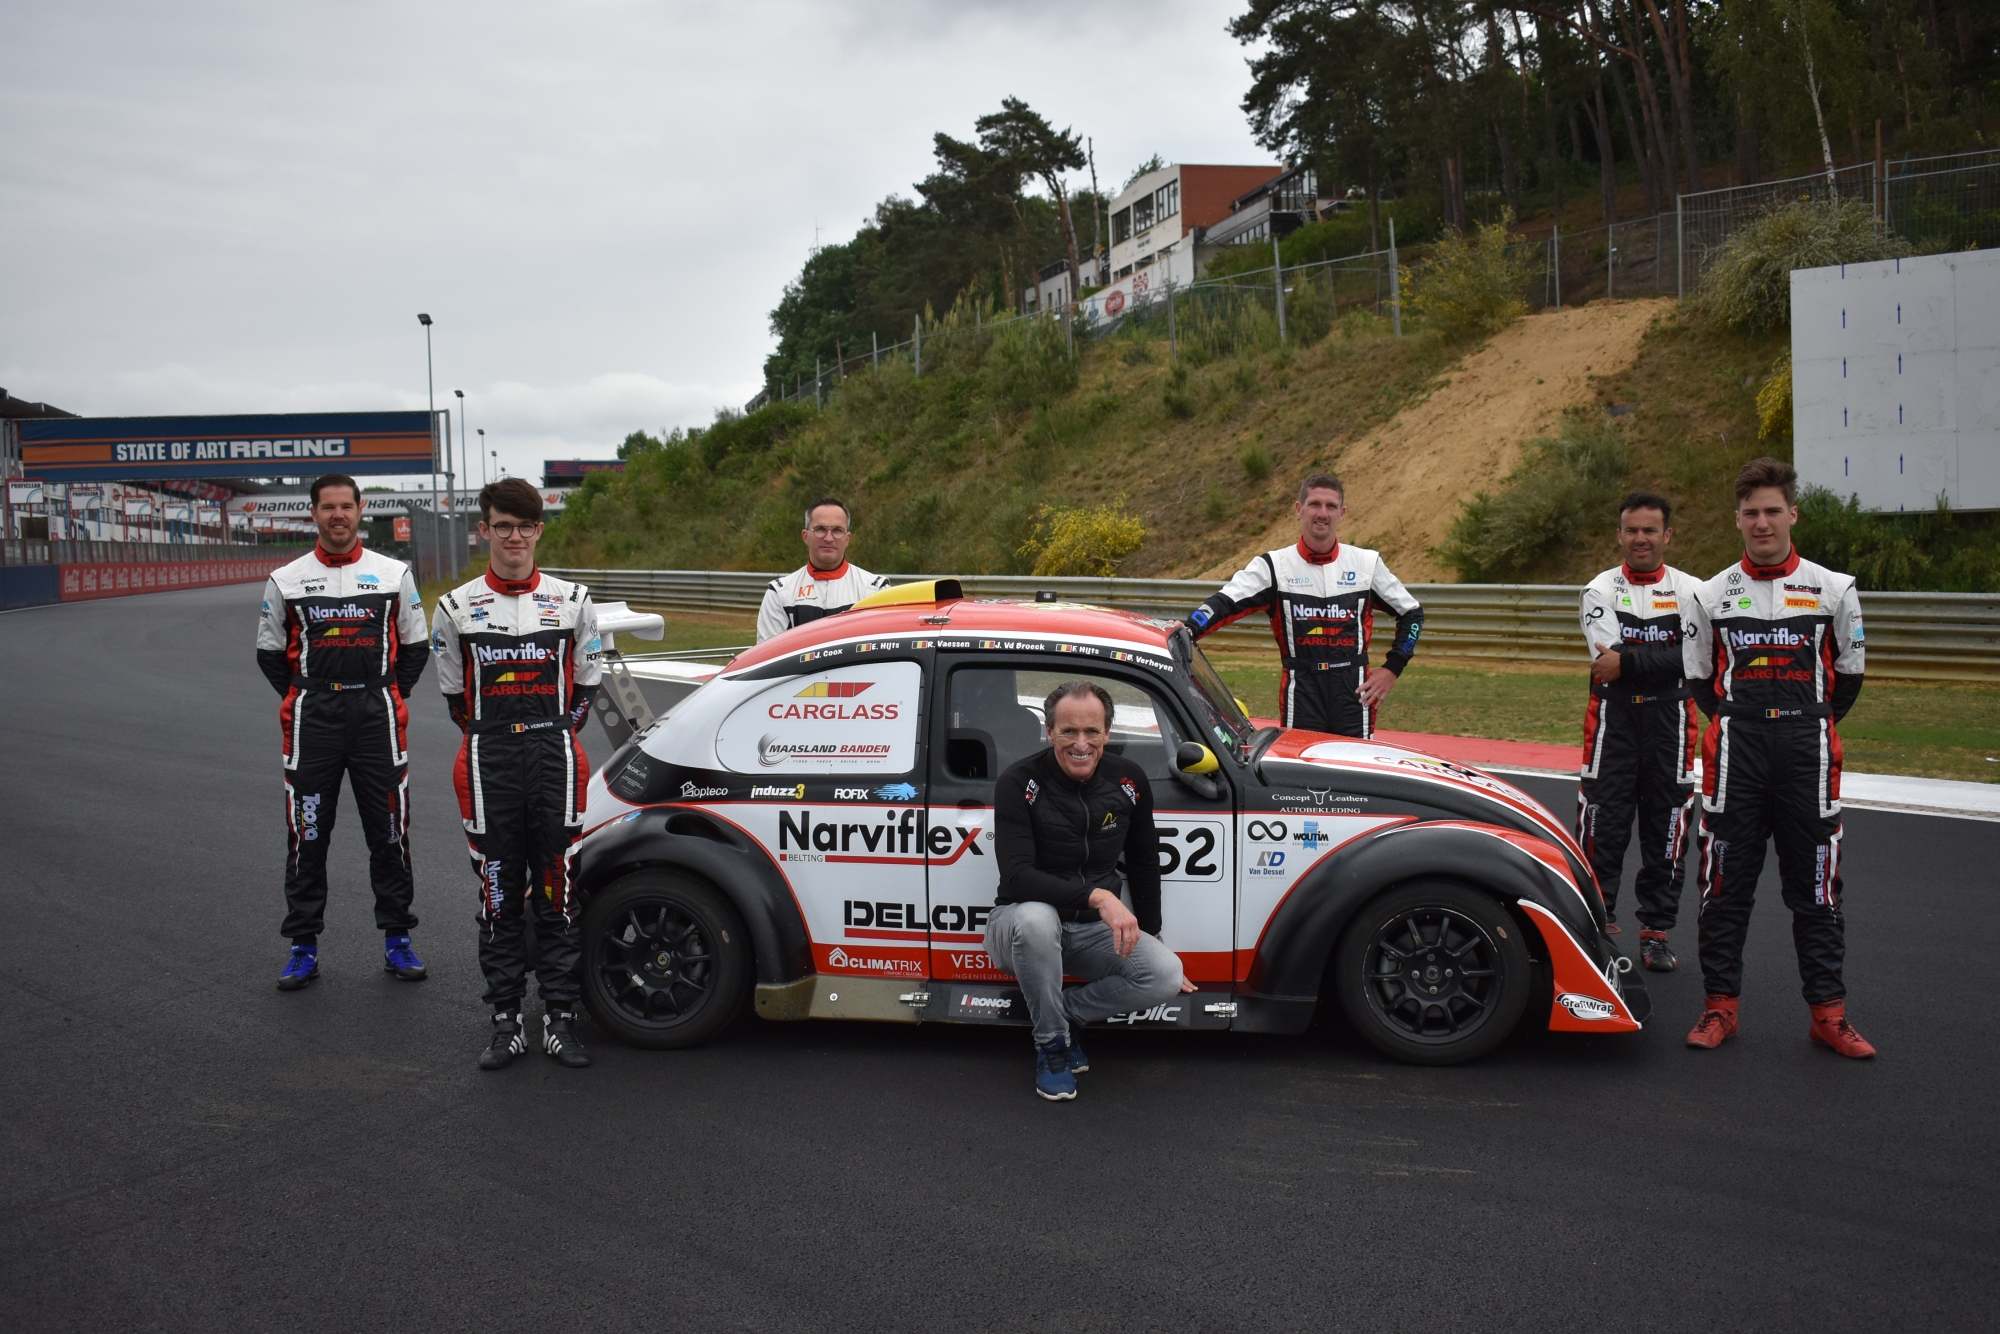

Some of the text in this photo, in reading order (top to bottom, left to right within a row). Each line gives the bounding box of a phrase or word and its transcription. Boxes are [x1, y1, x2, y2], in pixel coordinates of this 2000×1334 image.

[117, 439, 345, 461] STATE OF ART RACING
[798, 584, 814, 598] KT
[1787, 599, 1816, 608] PIRELLI
[308, 604, 376, 620] Narviflex
[1293, 604, 1356, 619] Narviflex
[312, 637, 376, 648] CARGLASS
[937, 640, 970, 648] Vaessen
[1296, 636, 1356, 647] CARGLASS
[1730, 628, 1811, 647] Narviflex
[477, 642, 556, 663] Narviflex
[1016, 642, 1045, 650] Broeck
[823, 649, 843, 658] Coox
[1136, 656, 1174, 672] Verheyen
[1734, 668, 1812, 681] CARGLASS
[482, 684, 556, 696] CARGLASS
[768, 704, 899, 720] CARGLASS
[769, 744, 890, 753] MAASLAND BANDEN
[694, 786, 728, 798] opteco
[751, 784, 805, 799] induzz3
[834, 788, 868, 800] ROFIX
[1272, 794, 1310, 802] Concept
[779, 808, 984, 856] Narviflex
[1664, 807, 1679, 860] DELORGE
[788, 854, 823, 862] BELTING
[1154, 827, 1217, 876] 52
[1263, 868, 1284, 876] Dessel
[1815, 845, 1826, 905] DELORGE
[849, 958, 922, 972] CLIMATRIX
[950, 954, 996, 969] VEST
[961, 993, 1012, 1008] KRONOS
[1562, 998, 1614, 1014] GrafiWrap
